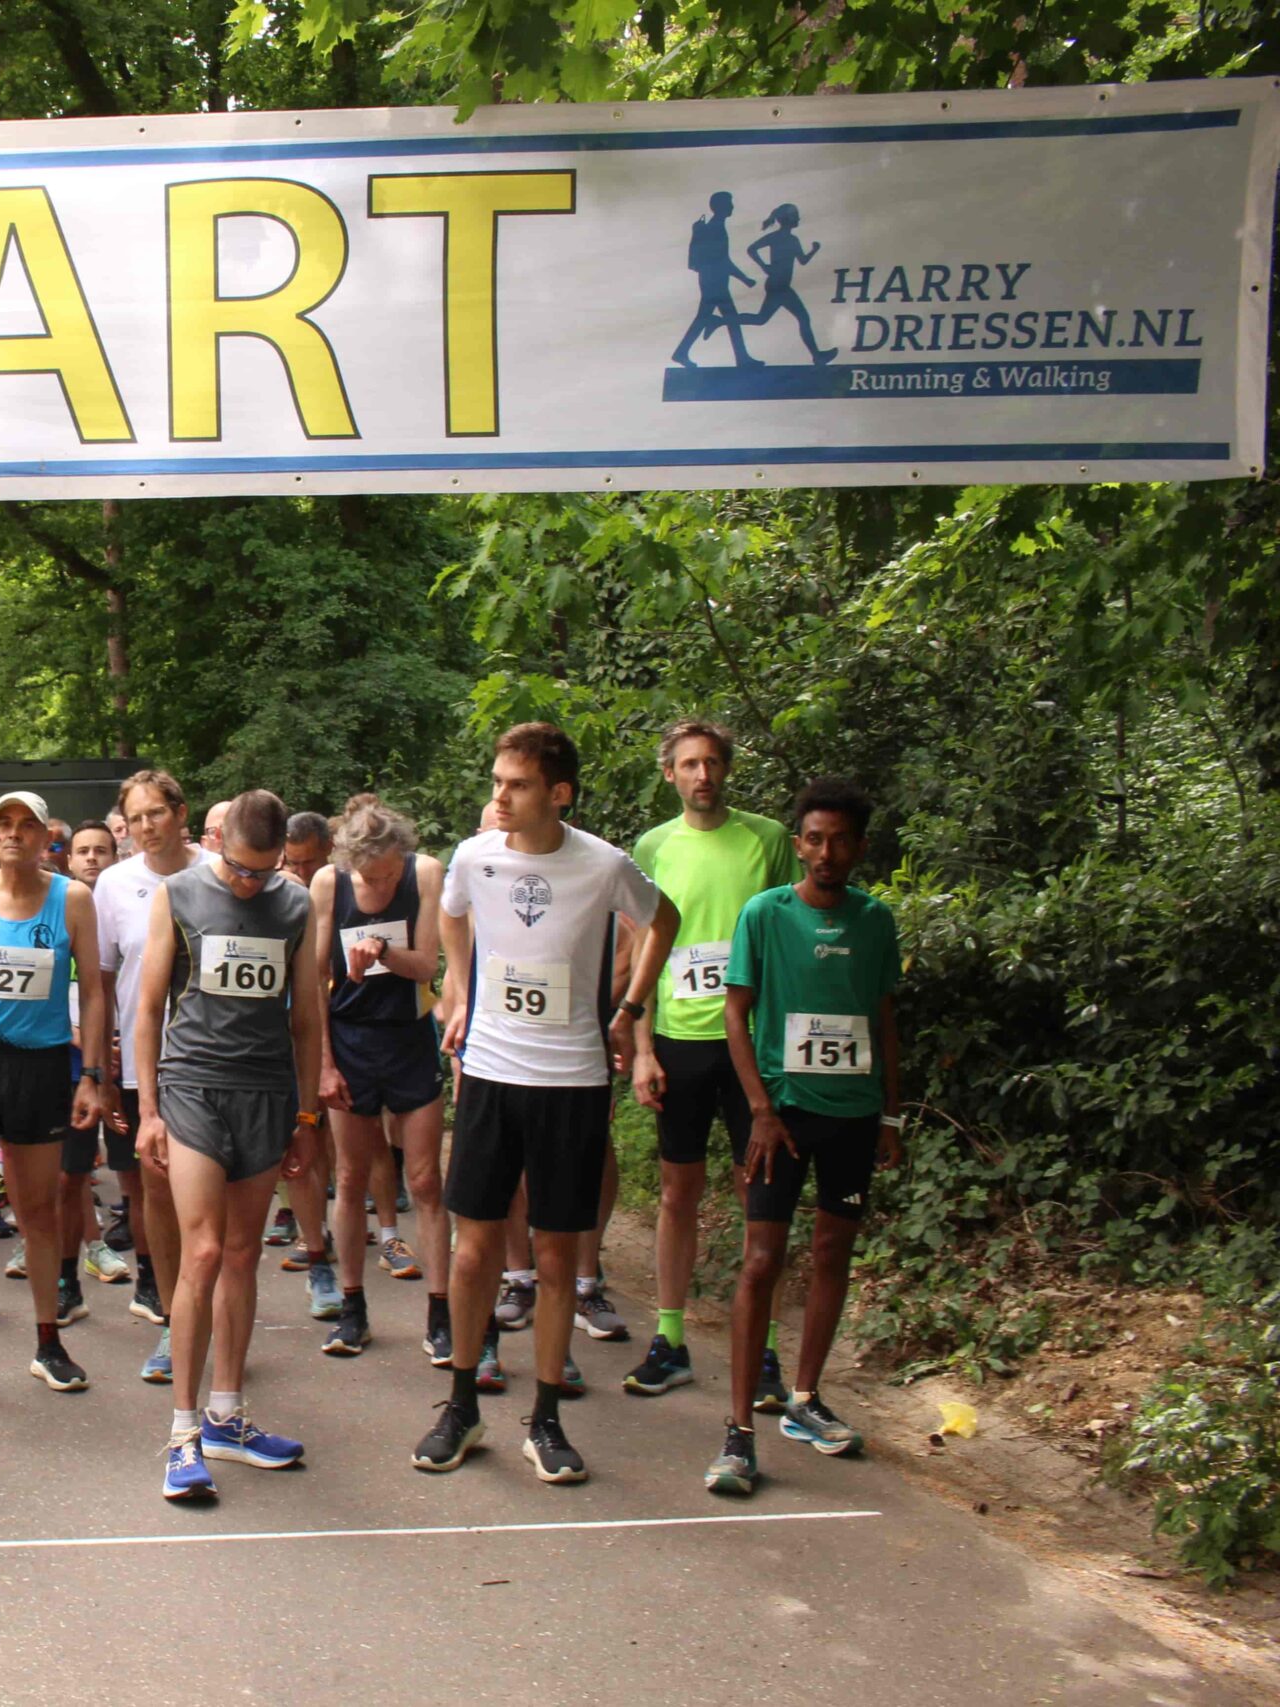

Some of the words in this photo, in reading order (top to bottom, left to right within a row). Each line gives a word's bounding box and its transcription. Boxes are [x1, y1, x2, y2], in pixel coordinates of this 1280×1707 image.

[830, 262, 1032, 304] HARRY
[851, 307, 1203, 352] DRIESSEN.NL
[849, 368, 964, 393] Running
[972, 367, 991, 389] &
[999, 365, 1112, 391] Walking
[214, 962, 276, 991] 160
[683, 965, 728, 992] 15
[504, 986, 546, 1016] 59
[797, 1040, 858, 1068] 151
